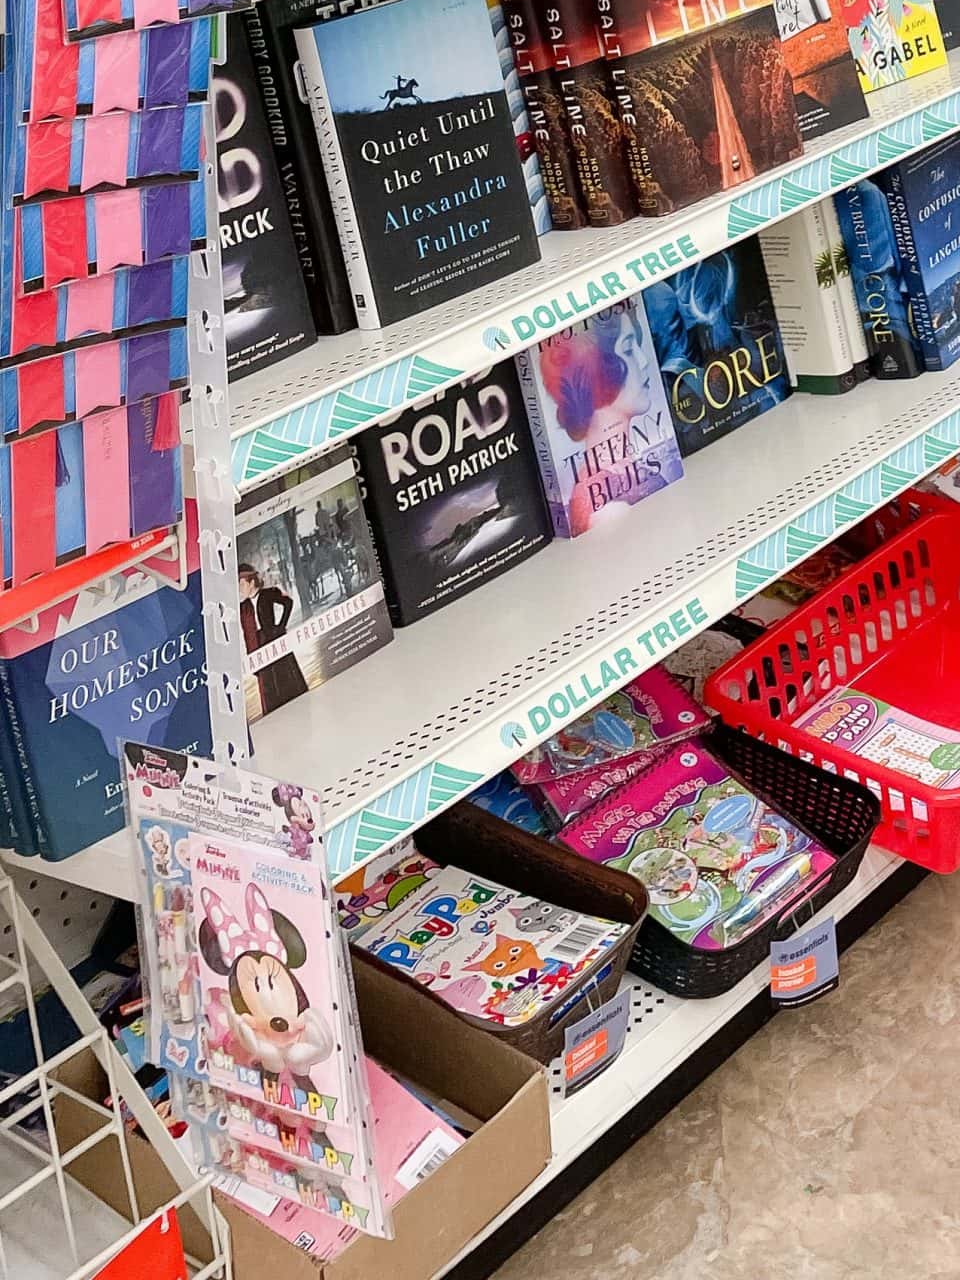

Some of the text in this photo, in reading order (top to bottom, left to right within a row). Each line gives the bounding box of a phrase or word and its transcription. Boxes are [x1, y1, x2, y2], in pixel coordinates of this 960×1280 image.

[510, 14, 534, 73] SALT
[525, 86, 550, 142] LINE
[547, 8, 570, 68] SALT
[561, 80, 586, 137] LINE
[873, 34, 937, 70] GABEL
[257, 64, 288, 146] GOODKIND
[612, 70, 636, 126] LINE
[361, 98, 496, 163] Quiet Until
[383, 141, 491, 195] the Thaw
[383, 172, 508, 233] Alexandra
[415, 216, 491, 261] Fuller
[511, 272, 626, 341] DOLLAR
[627, 234, 700, 282] TREE
[851, 210, 895, 345] BRETT CORE
[672, 331, 783, 425] CORE
[674, 397, 692, 412] THE
[380, 383, 512, 485] ROAD
[563, 412, 668, 485] TIFFANY
[396, 433, 519, 512] SETH PATRICK
[588, 453, 662, 513] BLUES
[59, 630, 120, 673] OUR
[296, 597, 367, 643] FREDERICKS
[48, 629, 195, 723] HOMESICK
[129, 662, 209, 722] SONGS
[528, 597, 709, 734] DOLLAR TREE
[842, 718, 871, 740] PAD
[263, 1073, 339, 1121] HAPPY
